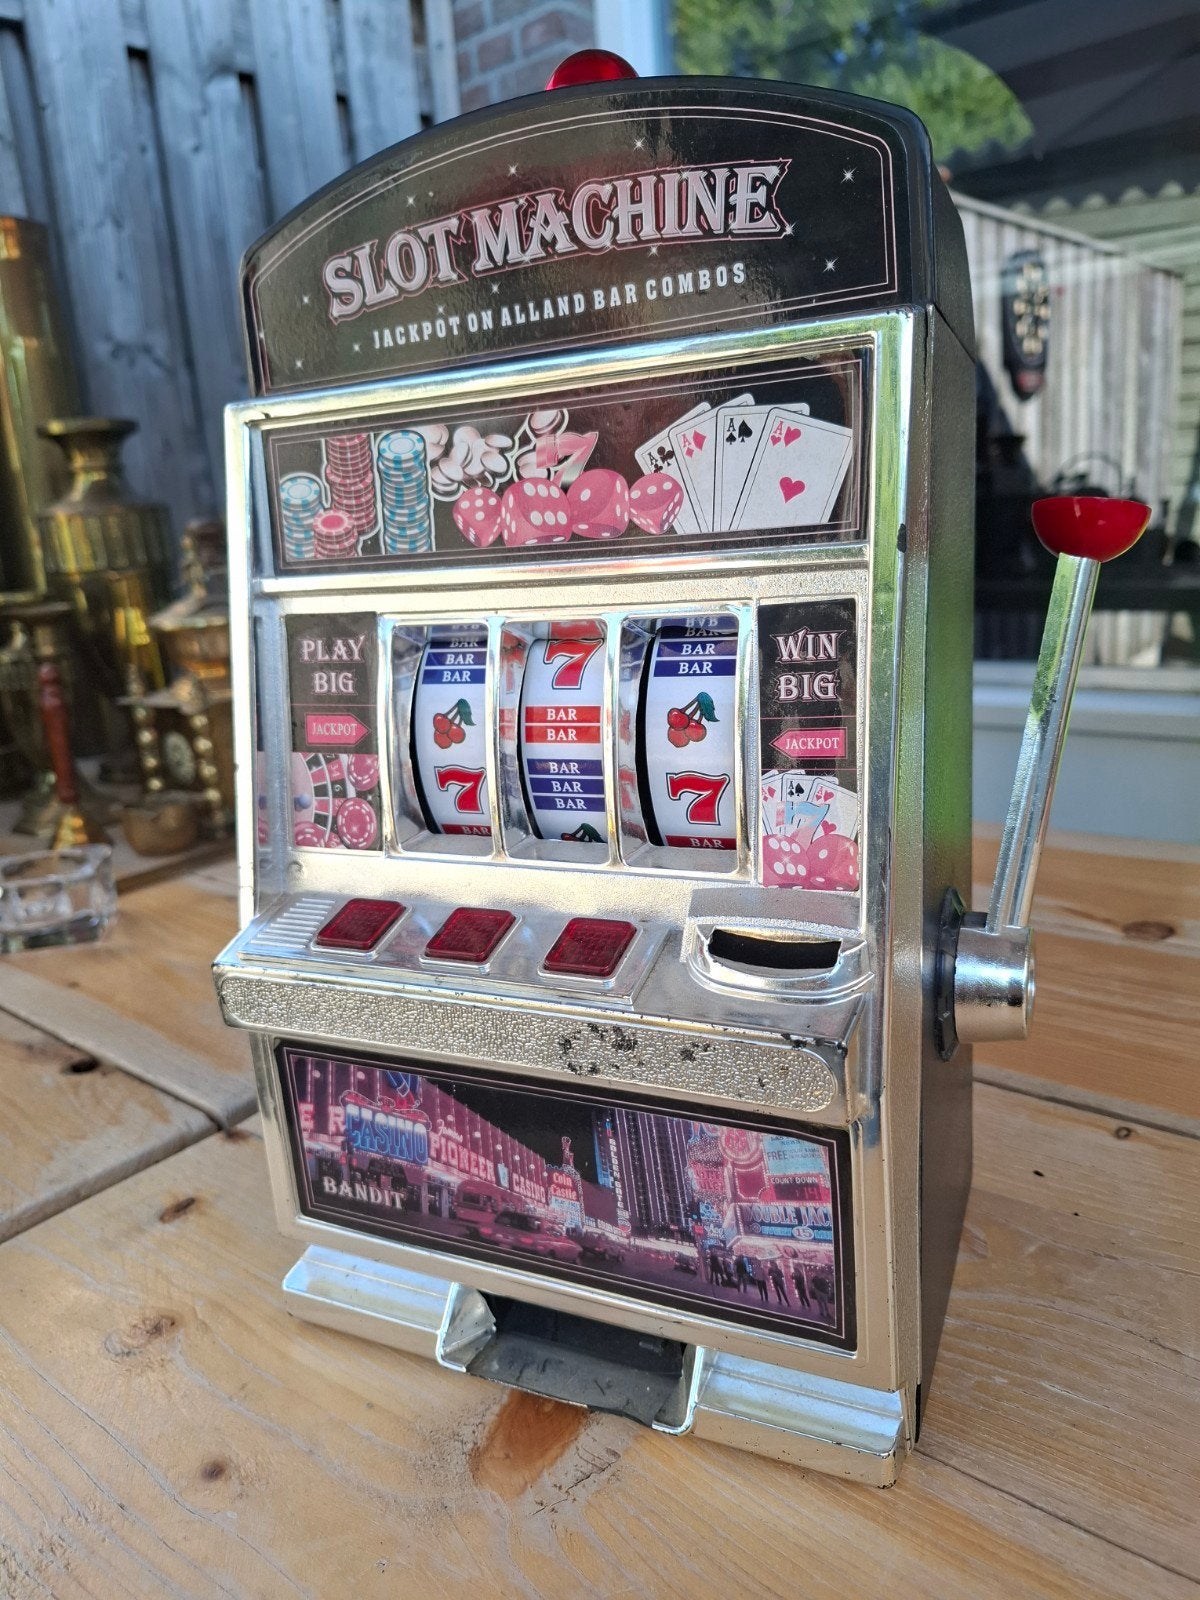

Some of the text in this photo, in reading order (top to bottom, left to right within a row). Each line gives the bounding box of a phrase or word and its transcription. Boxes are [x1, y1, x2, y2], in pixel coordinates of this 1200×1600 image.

[324, 163, 789, 320] SLOT MACHINE
[372, 315, 460, 350] JACKPOT
[467, 309, 494, 333] ON
[594, 283, 638, 310] BAR
[645, 262, 746, 301] COMBOS
[300, 634, 367, 662] PLAY
[681, 643, 716, 655] BAR
[773, 629, 843, 662] WIN
[445, 653, 475, 665] BAR
[543, 638, 605, 690] 7
[678, 661, 713, 674] BAR
[313, 671, 357, 694] BIG
[442, 670, 472, 682] BAR
[777, 672, 840, 701] BIG
[547, 708, 578, 721] BAR
[312, 721, 358, 737] JACKPOT
[547, 728, 578, 741] BAR
[785, 737, 840, 750] JACKPOT
[549, 761, 581, 774] BAR
[434, 764, 488, 815] 7
[551, 780, 584, 793] BAR
[555, 797, 587, 810] BAR
[666, 770, 731, 826] 7
[461, 826, 491, 836] BAR
[689, 838, 725, 848] BAR
[345, 1103, 428, 1165] CASINO
[430, 1131, 496, 1185] PIONEER
[767, 1149, 788, 1161] FREE
[552, 1171, 573, 1187] Coin
[795, 1176, 818, 1184] DOWN
[323, 1176, 404, 1210] BANDIT
[512, 1172, 547, 1205] CASINO
[550, 1183, 578, 1200] Castle
